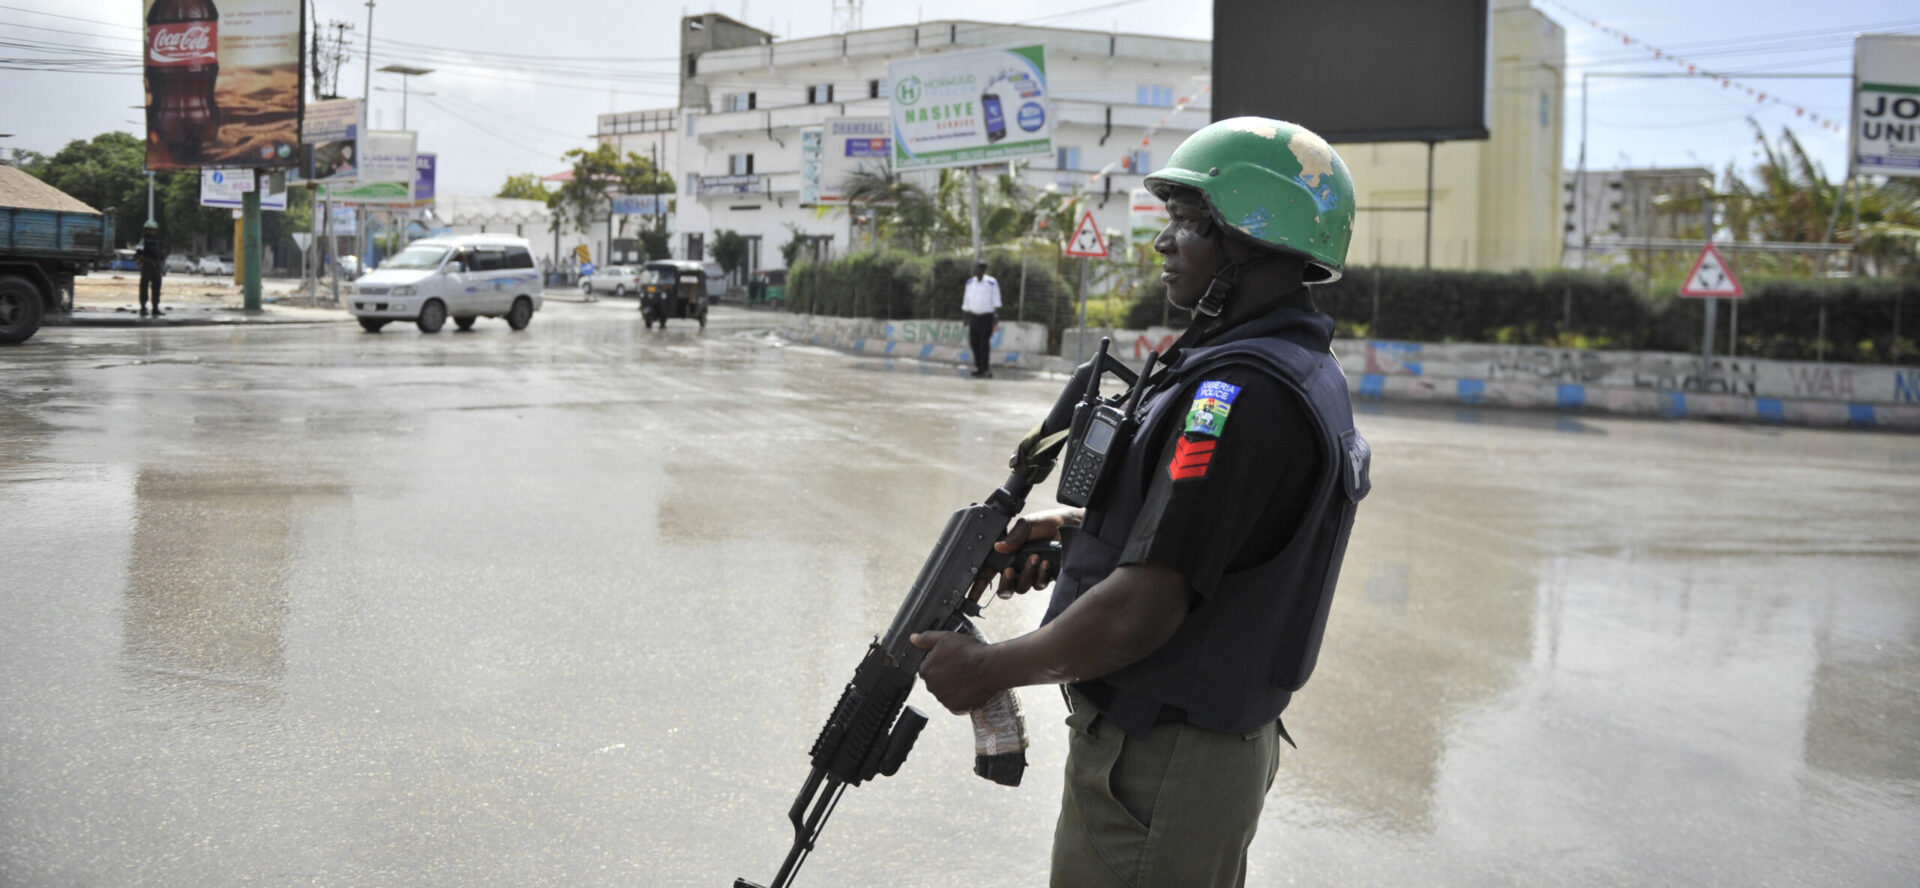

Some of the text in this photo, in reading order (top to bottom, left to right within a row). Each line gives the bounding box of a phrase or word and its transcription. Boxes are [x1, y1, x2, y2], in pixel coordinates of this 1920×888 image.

[154, 26, 211, 51] Coca-Cola
[905, 101, 974, 123] NASIYE
[1863, 121, 1920, 142] UNI
[1200, 389, 1229, 400] POLICE
[1201, 381, 1235, 394] NIGERIA
